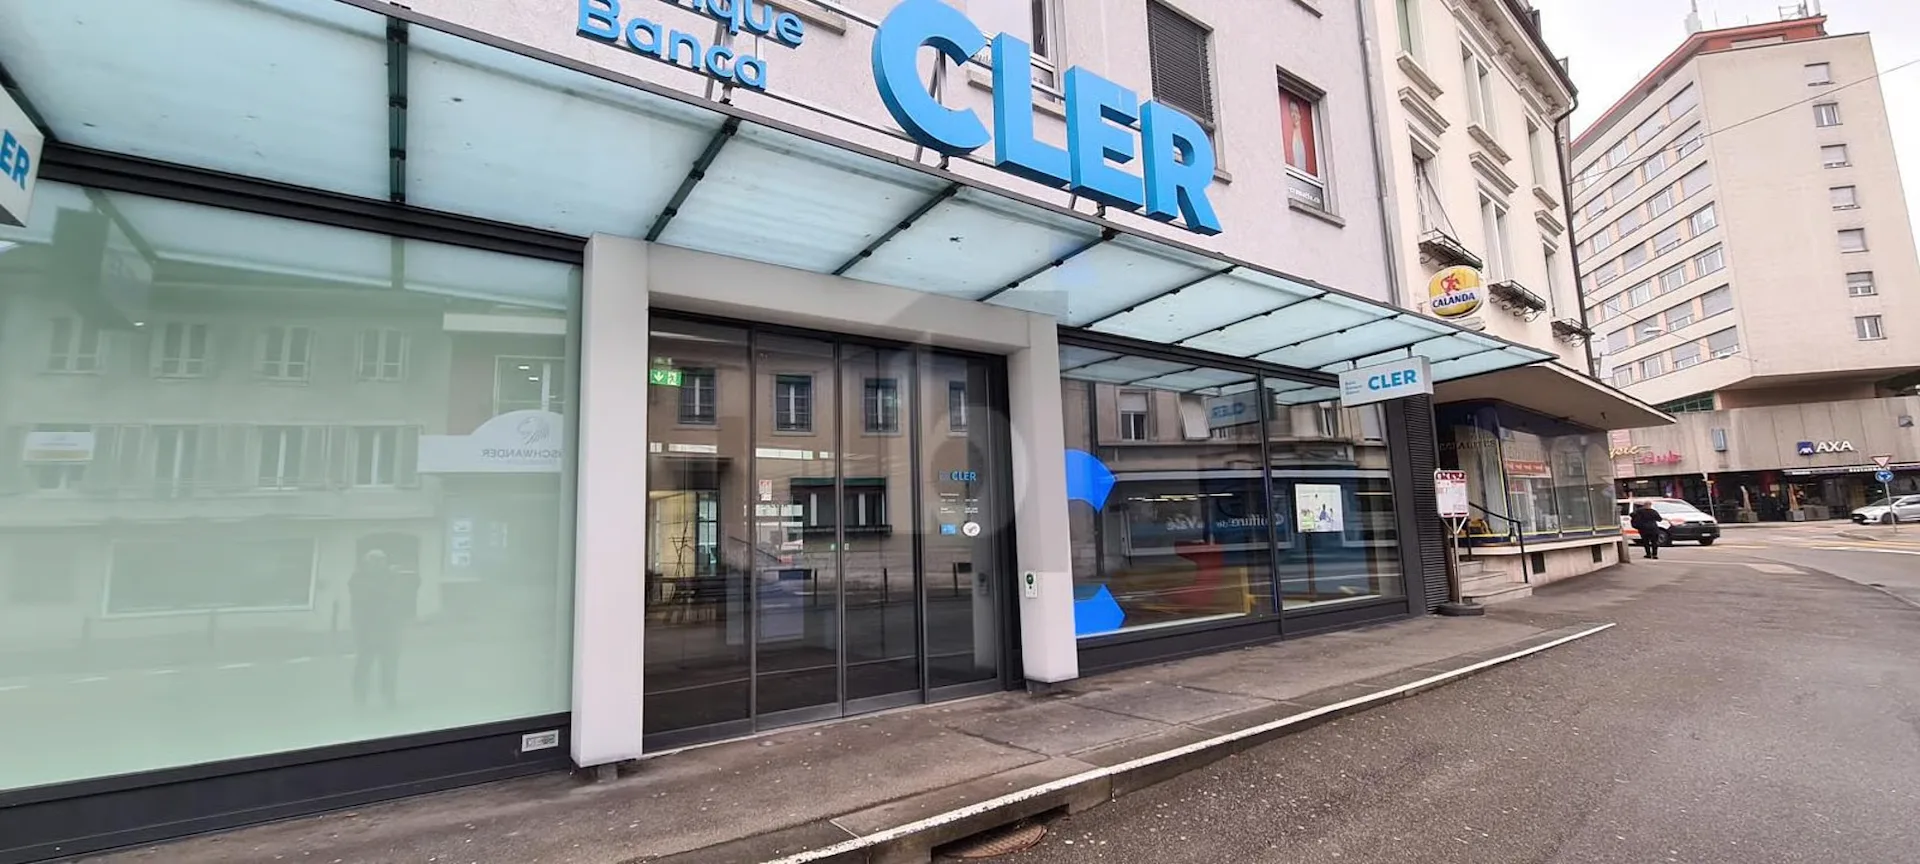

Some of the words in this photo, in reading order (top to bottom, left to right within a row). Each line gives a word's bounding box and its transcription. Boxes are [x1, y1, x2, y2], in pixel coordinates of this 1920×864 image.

[576, 0, 767, 91] Banca
[871, 0, 1222, 237] CLER
[0, 129, 30, 191] ER
[1432, 292, 1475, 308] CALANDA
[1368, 369, 1417, 390] CLER
[1815, 440, 1854, 453] AXA
[951, 471, 977, 482] CLER
